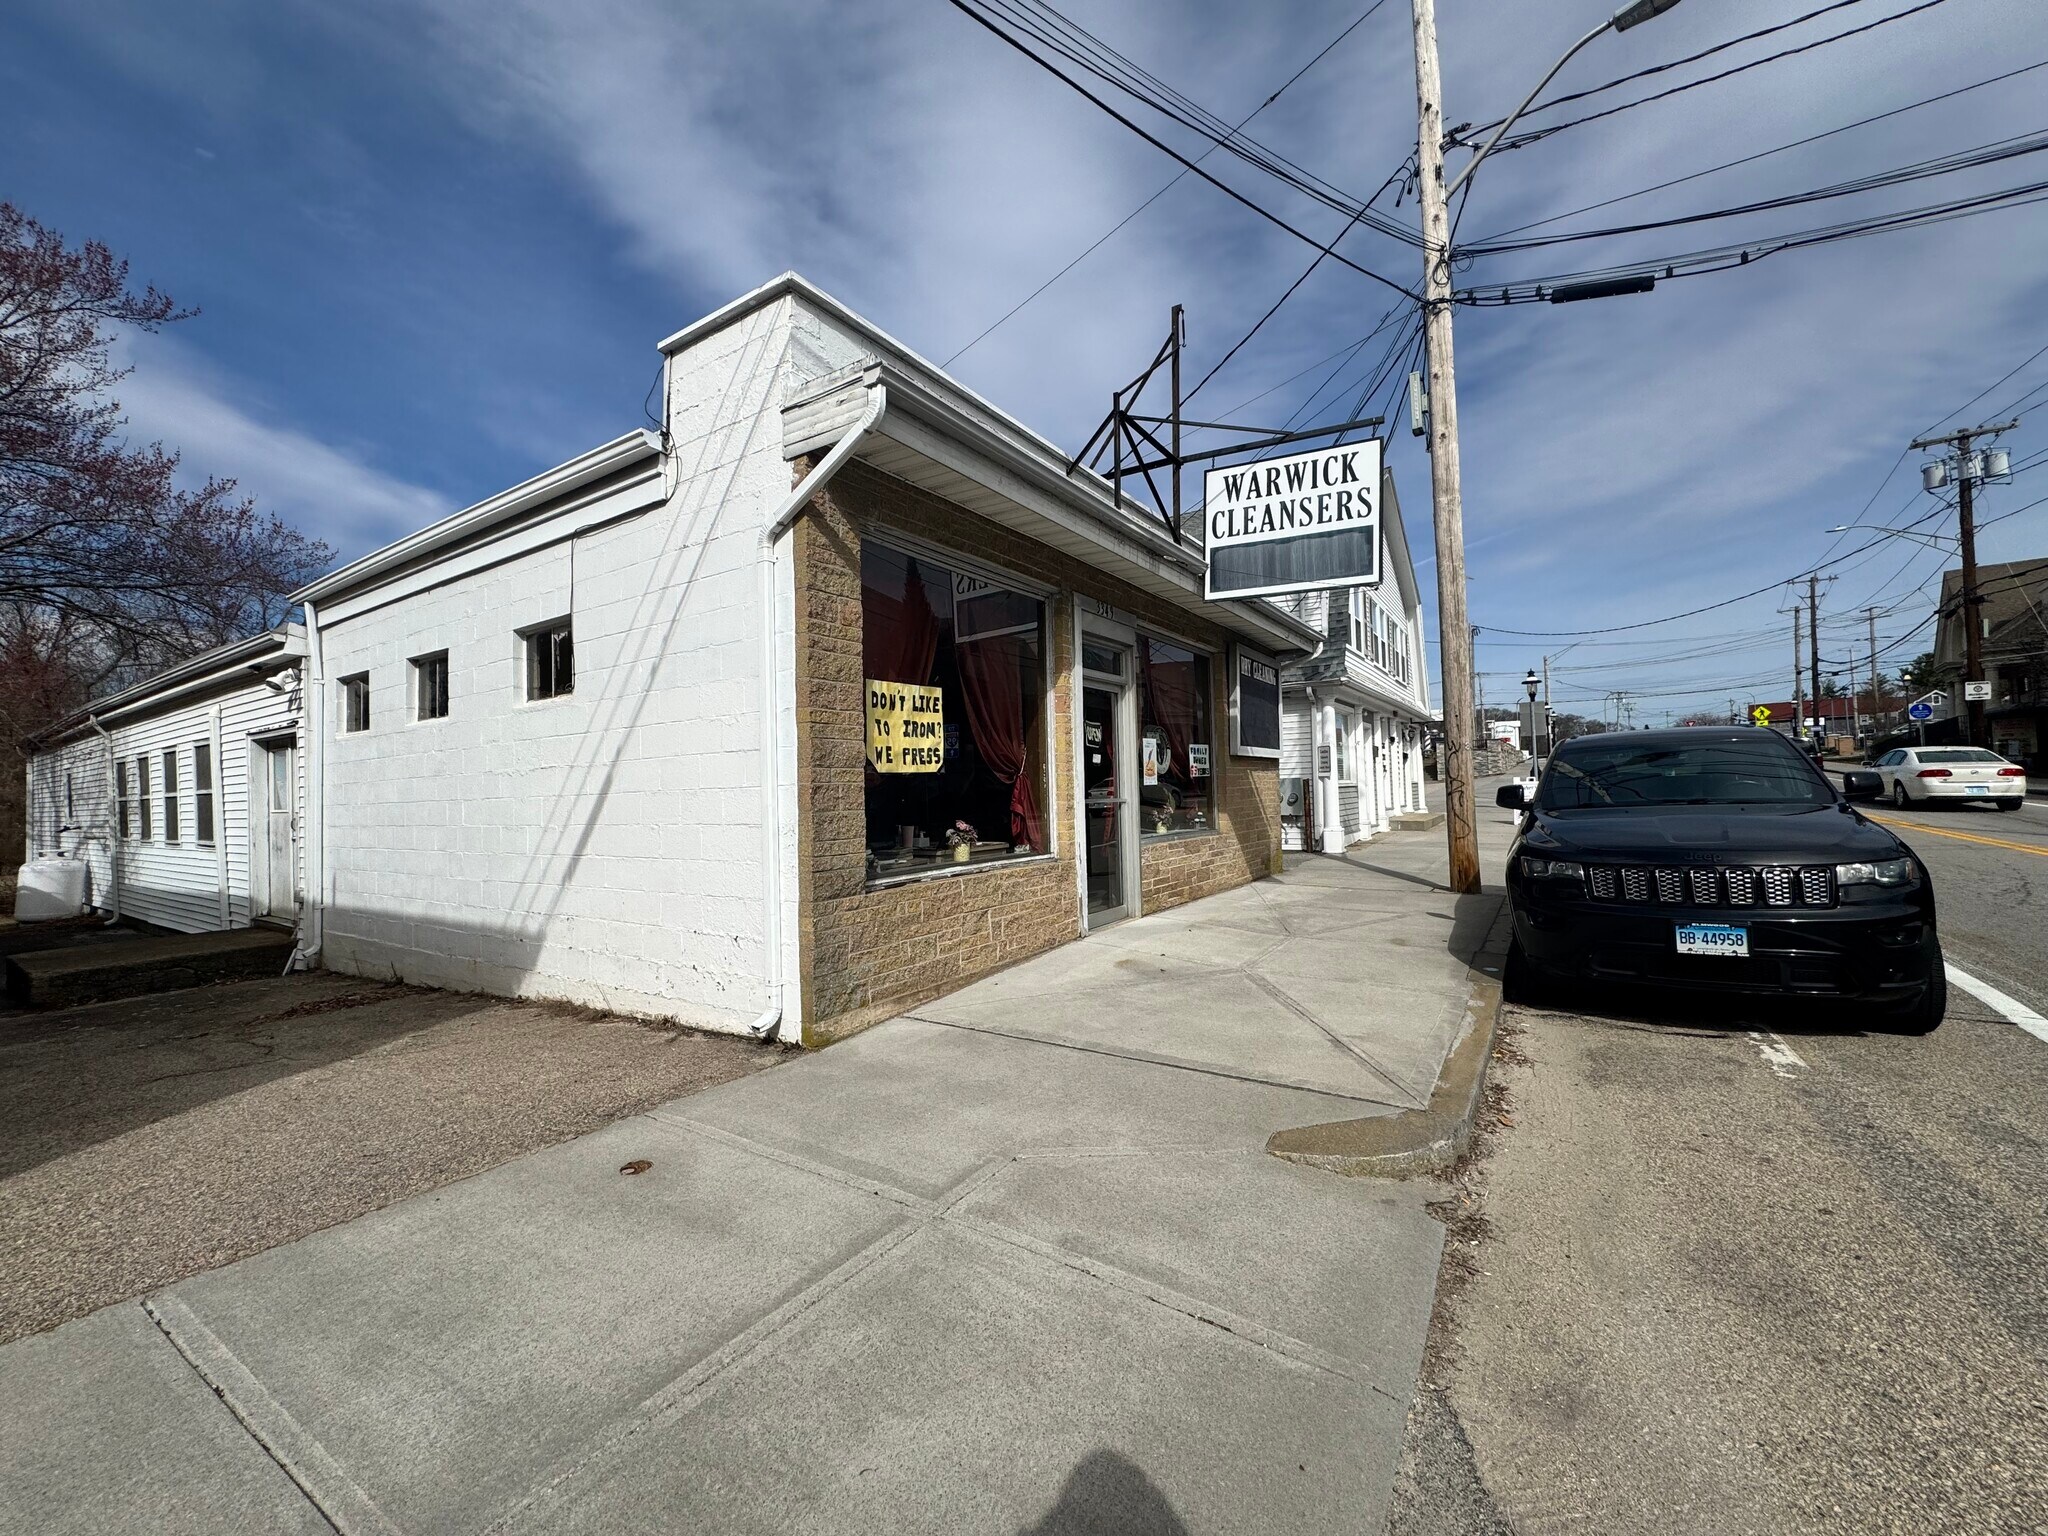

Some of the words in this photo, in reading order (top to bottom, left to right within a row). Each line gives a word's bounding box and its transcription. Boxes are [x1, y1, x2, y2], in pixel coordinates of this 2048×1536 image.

[1223, 451, 1360, 503] WARWICK
[1212, 486, 1373, 540] CLEANSERS
[1240, 655, 1252, 677] DRY
[871, 689, 906, 711] DON'T
[912, 694, 940, 713] LIKE
[874, 718, 891, 737] TO
[902, 719, 942, 739] IRON?
[875, 745, 893, 765] WE
[902, 747, 941, 766] PRESS
[1684, 852, 1722, 863] Jeep
